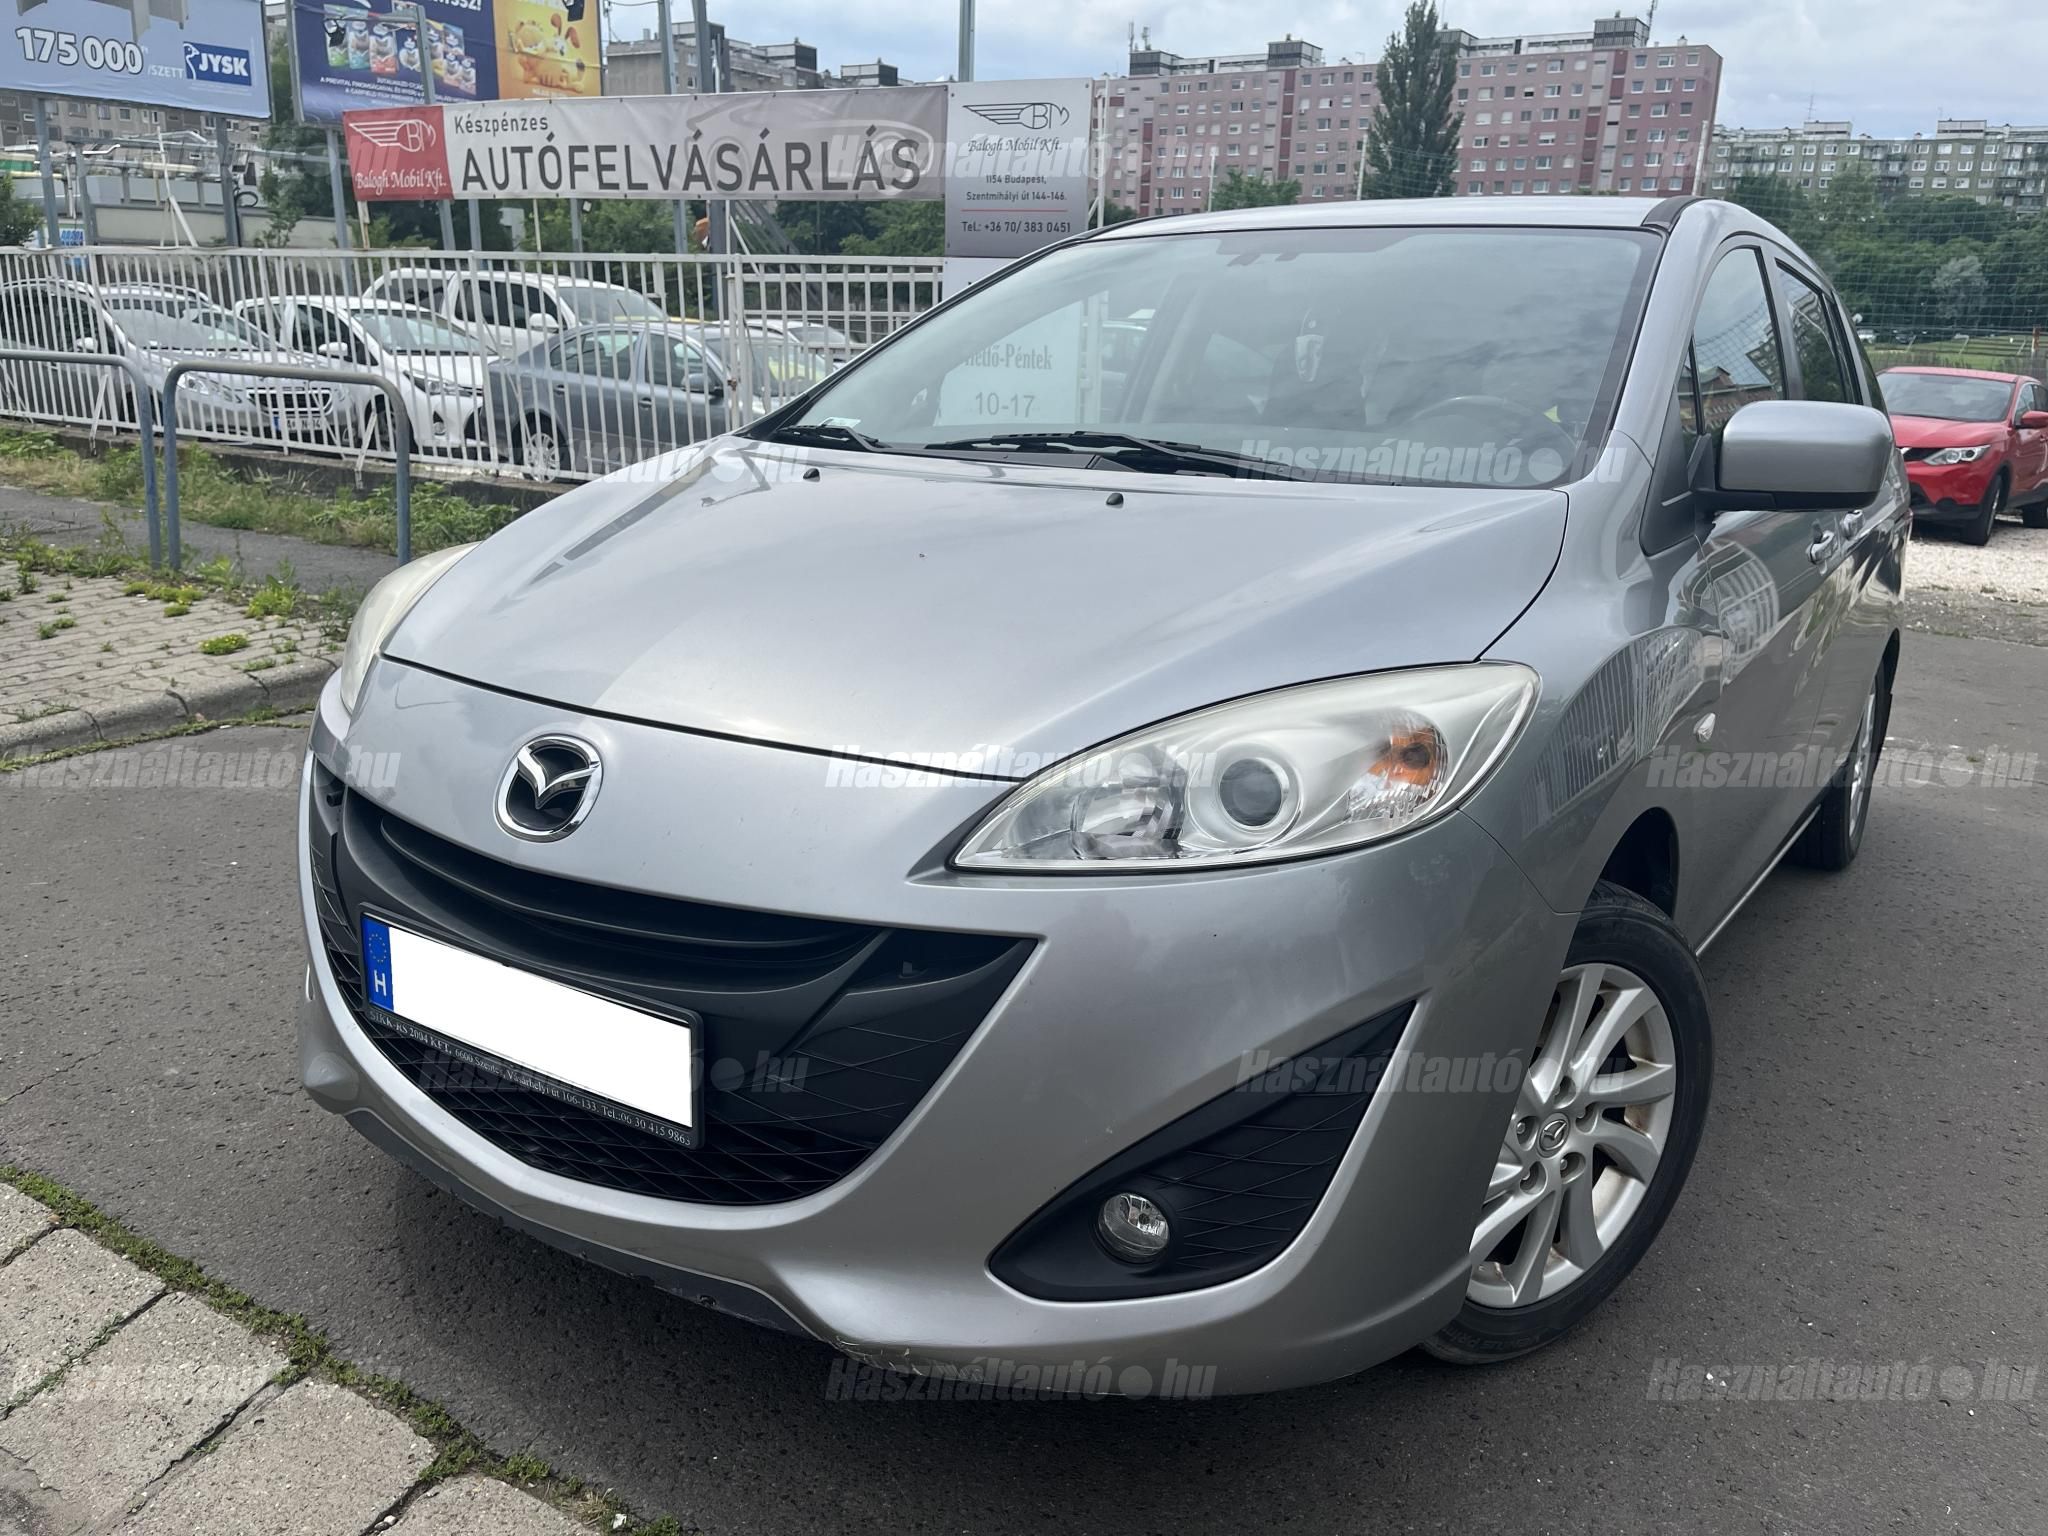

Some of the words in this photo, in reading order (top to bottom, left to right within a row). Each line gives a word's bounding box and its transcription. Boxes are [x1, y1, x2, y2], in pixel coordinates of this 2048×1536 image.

[15, 26, 79, 65] 175
[82, 35, 144, 75] 000
[199, 52, 249, 76] JYSK
[455, 112, 548, 137] Készpénzes
[462, 124, 921, 191] AUTÓFELVÁSÁRLÁS
[967, 137, 1002, 156] Balogh
[1005, 137, 1039, 152] Mobil
[355, 169, 389, 195] Balogh
[391, 168, 424, 188] Mobil
[986, 175, 1002, 184] 1154
[1004, 175, 1047, 185] Budapest,
[966, 191, 1020, 202] Szentmihályi
[984, 221, 1001, 232] +36
[1024, 222, 1043, 232] 383
[1046, 222, 1071, 233] 0451
[976, 391, 1036, 418] 10-17
[374, 969, 387, 997] H
[634, 1116, 646, 1129] 30
[648, 1122, 666, 1136] 415
